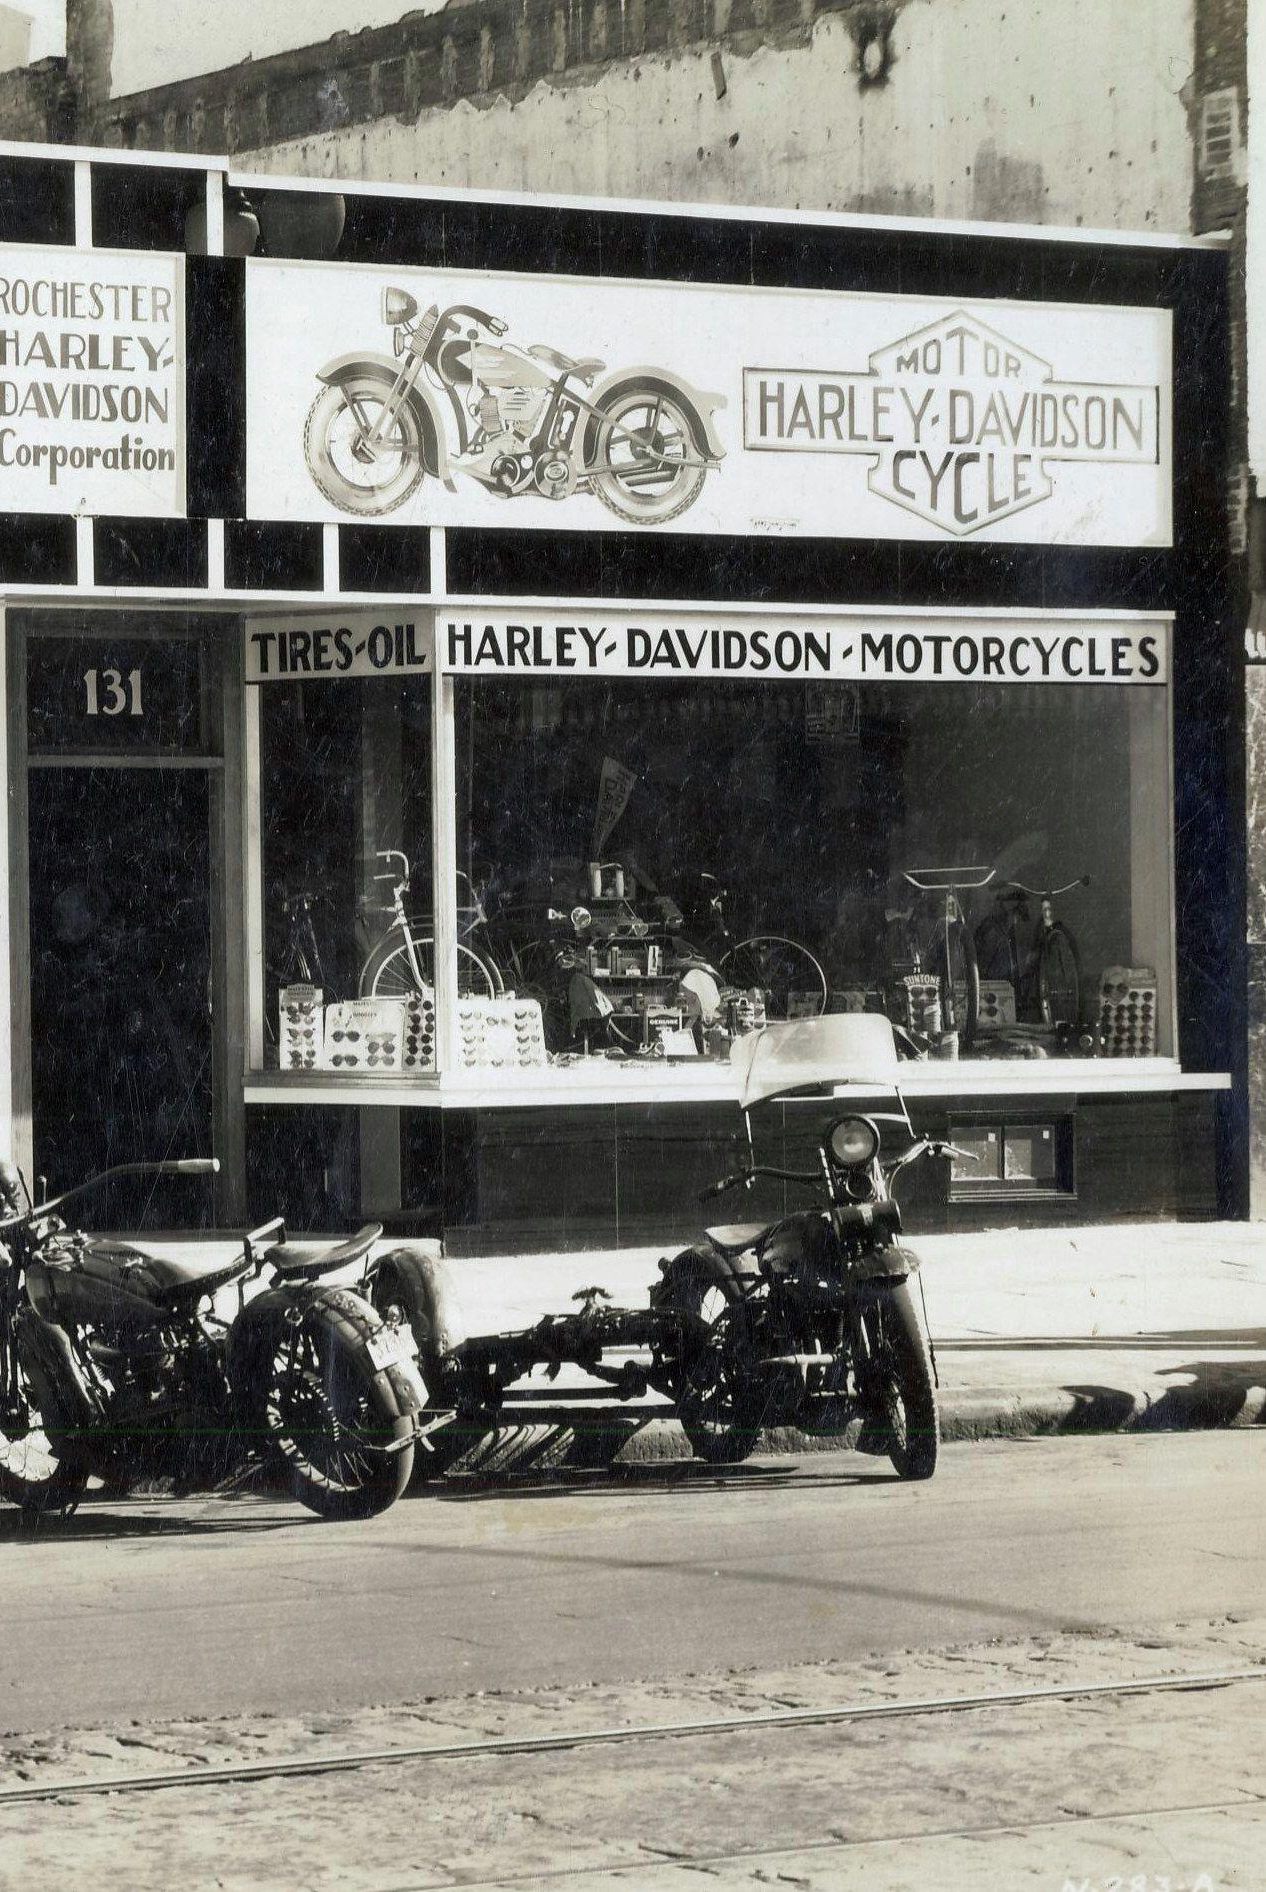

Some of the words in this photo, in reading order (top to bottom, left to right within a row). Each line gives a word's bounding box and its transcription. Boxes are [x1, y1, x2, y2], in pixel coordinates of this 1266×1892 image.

[895, 325, 1022, 379] MOTOR
[891, 448, 1033, 525] CYCLE
[82, 668, 145, 716] 131
